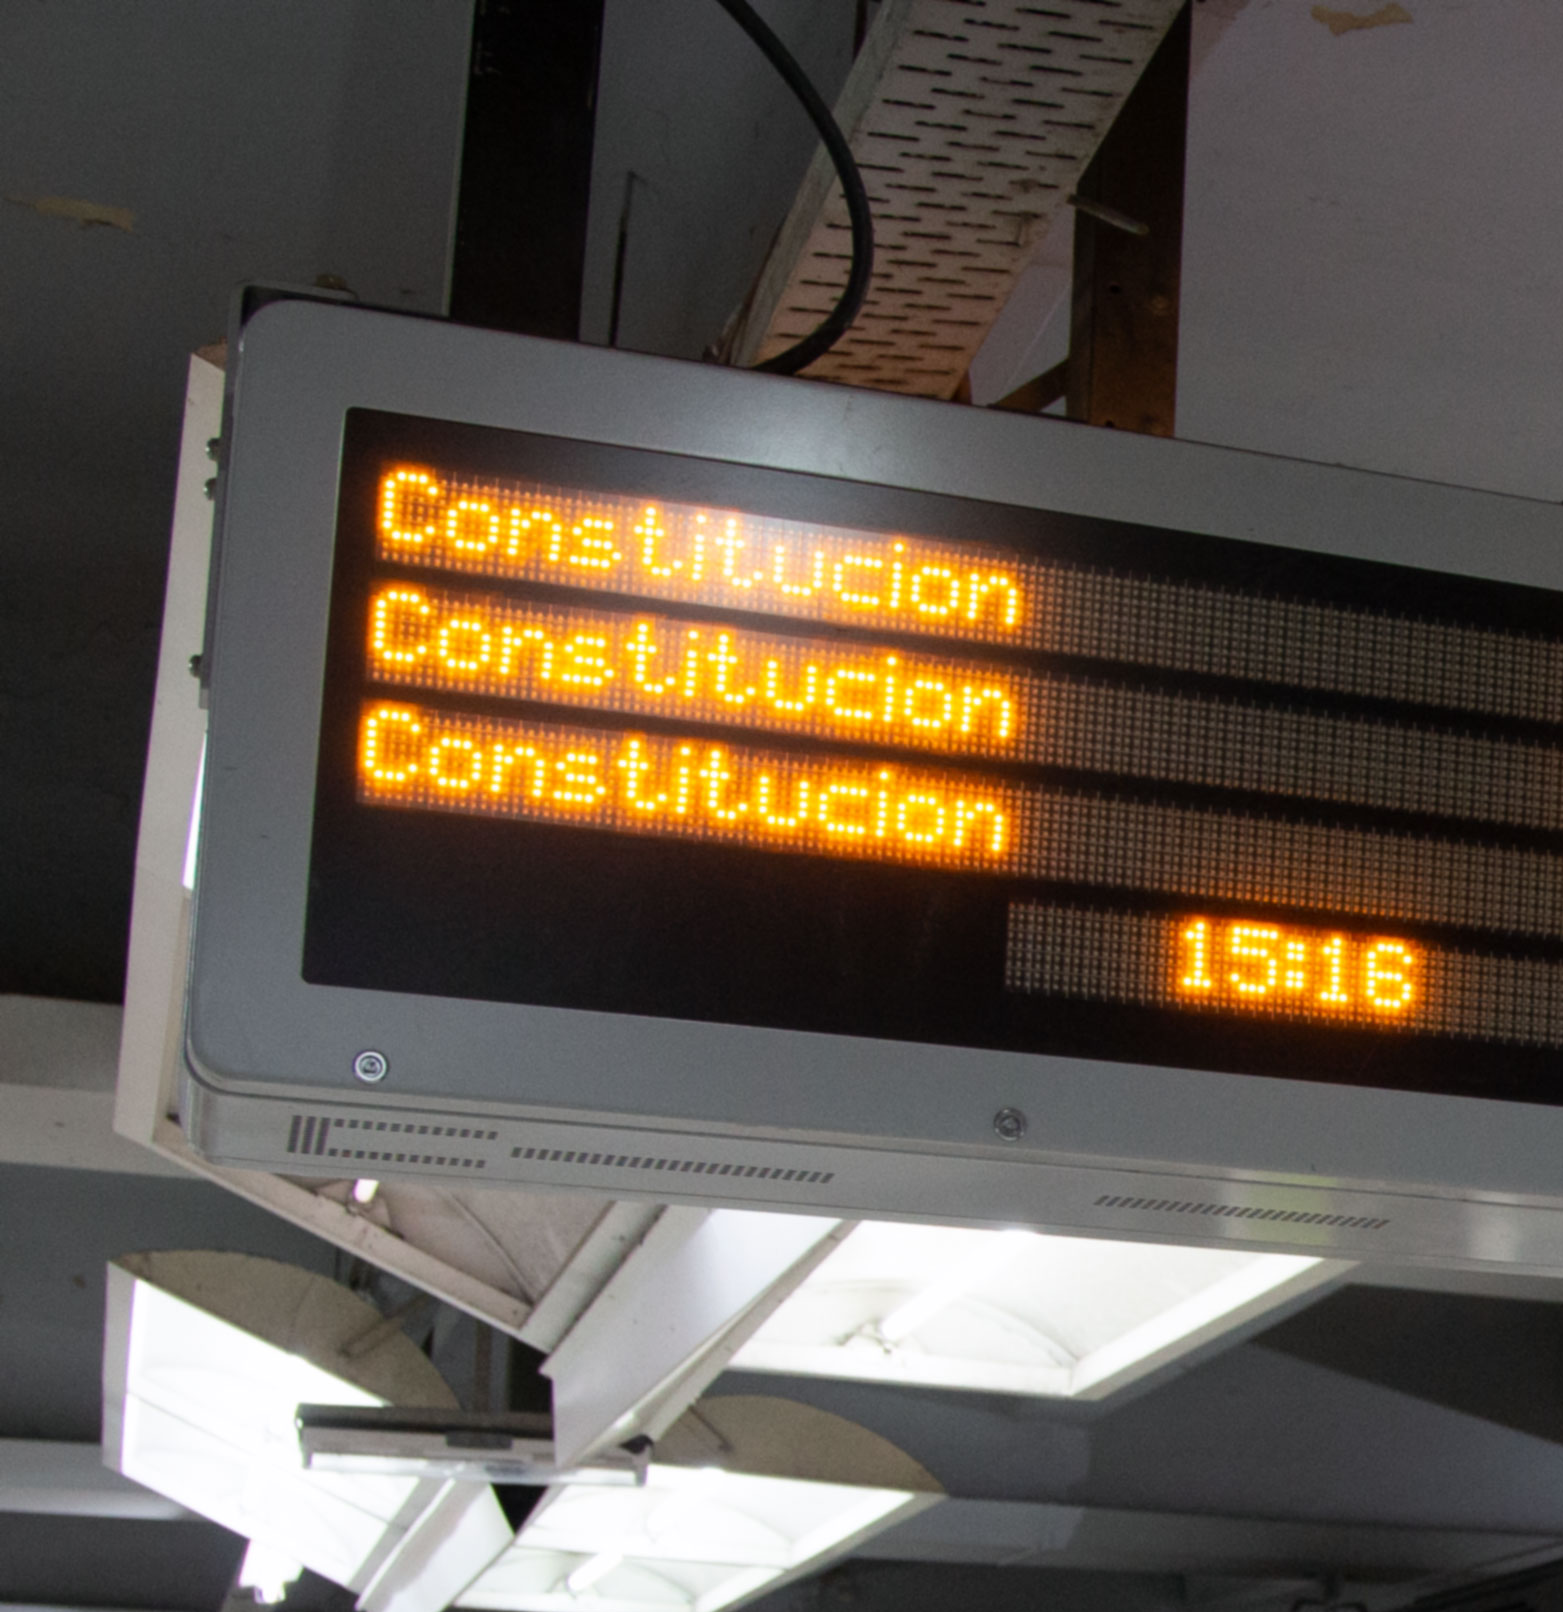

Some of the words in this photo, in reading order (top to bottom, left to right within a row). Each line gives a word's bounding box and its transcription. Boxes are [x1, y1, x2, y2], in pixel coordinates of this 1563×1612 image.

[378, 468, 1021, 631] Constitucion
[370, 587, 1014, 740] Constitucion
[360, 706, 1006, 854] Constitucion
[1180, 919, 1415, 1011] 15:16
